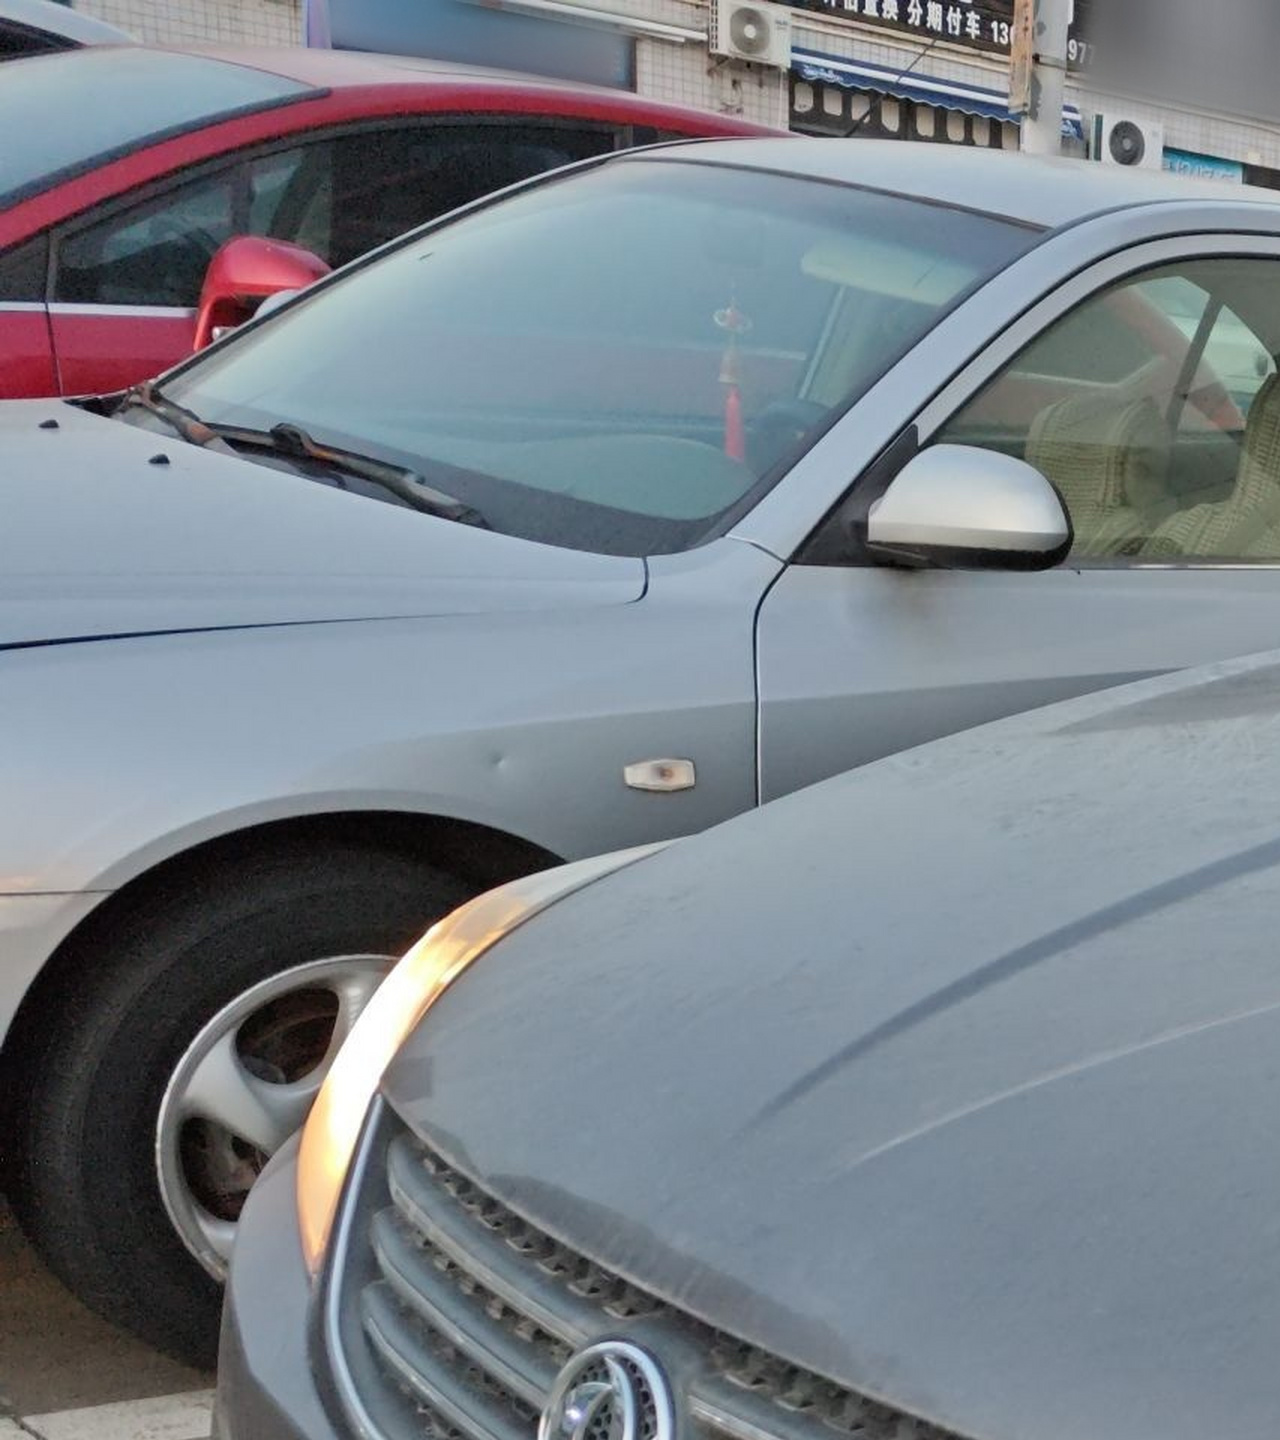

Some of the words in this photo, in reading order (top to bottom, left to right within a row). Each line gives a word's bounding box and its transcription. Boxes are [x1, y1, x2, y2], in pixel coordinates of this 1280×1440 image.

[907, 0, 981, 40] 分期付车
[990, 20, 1014, 45] 13
